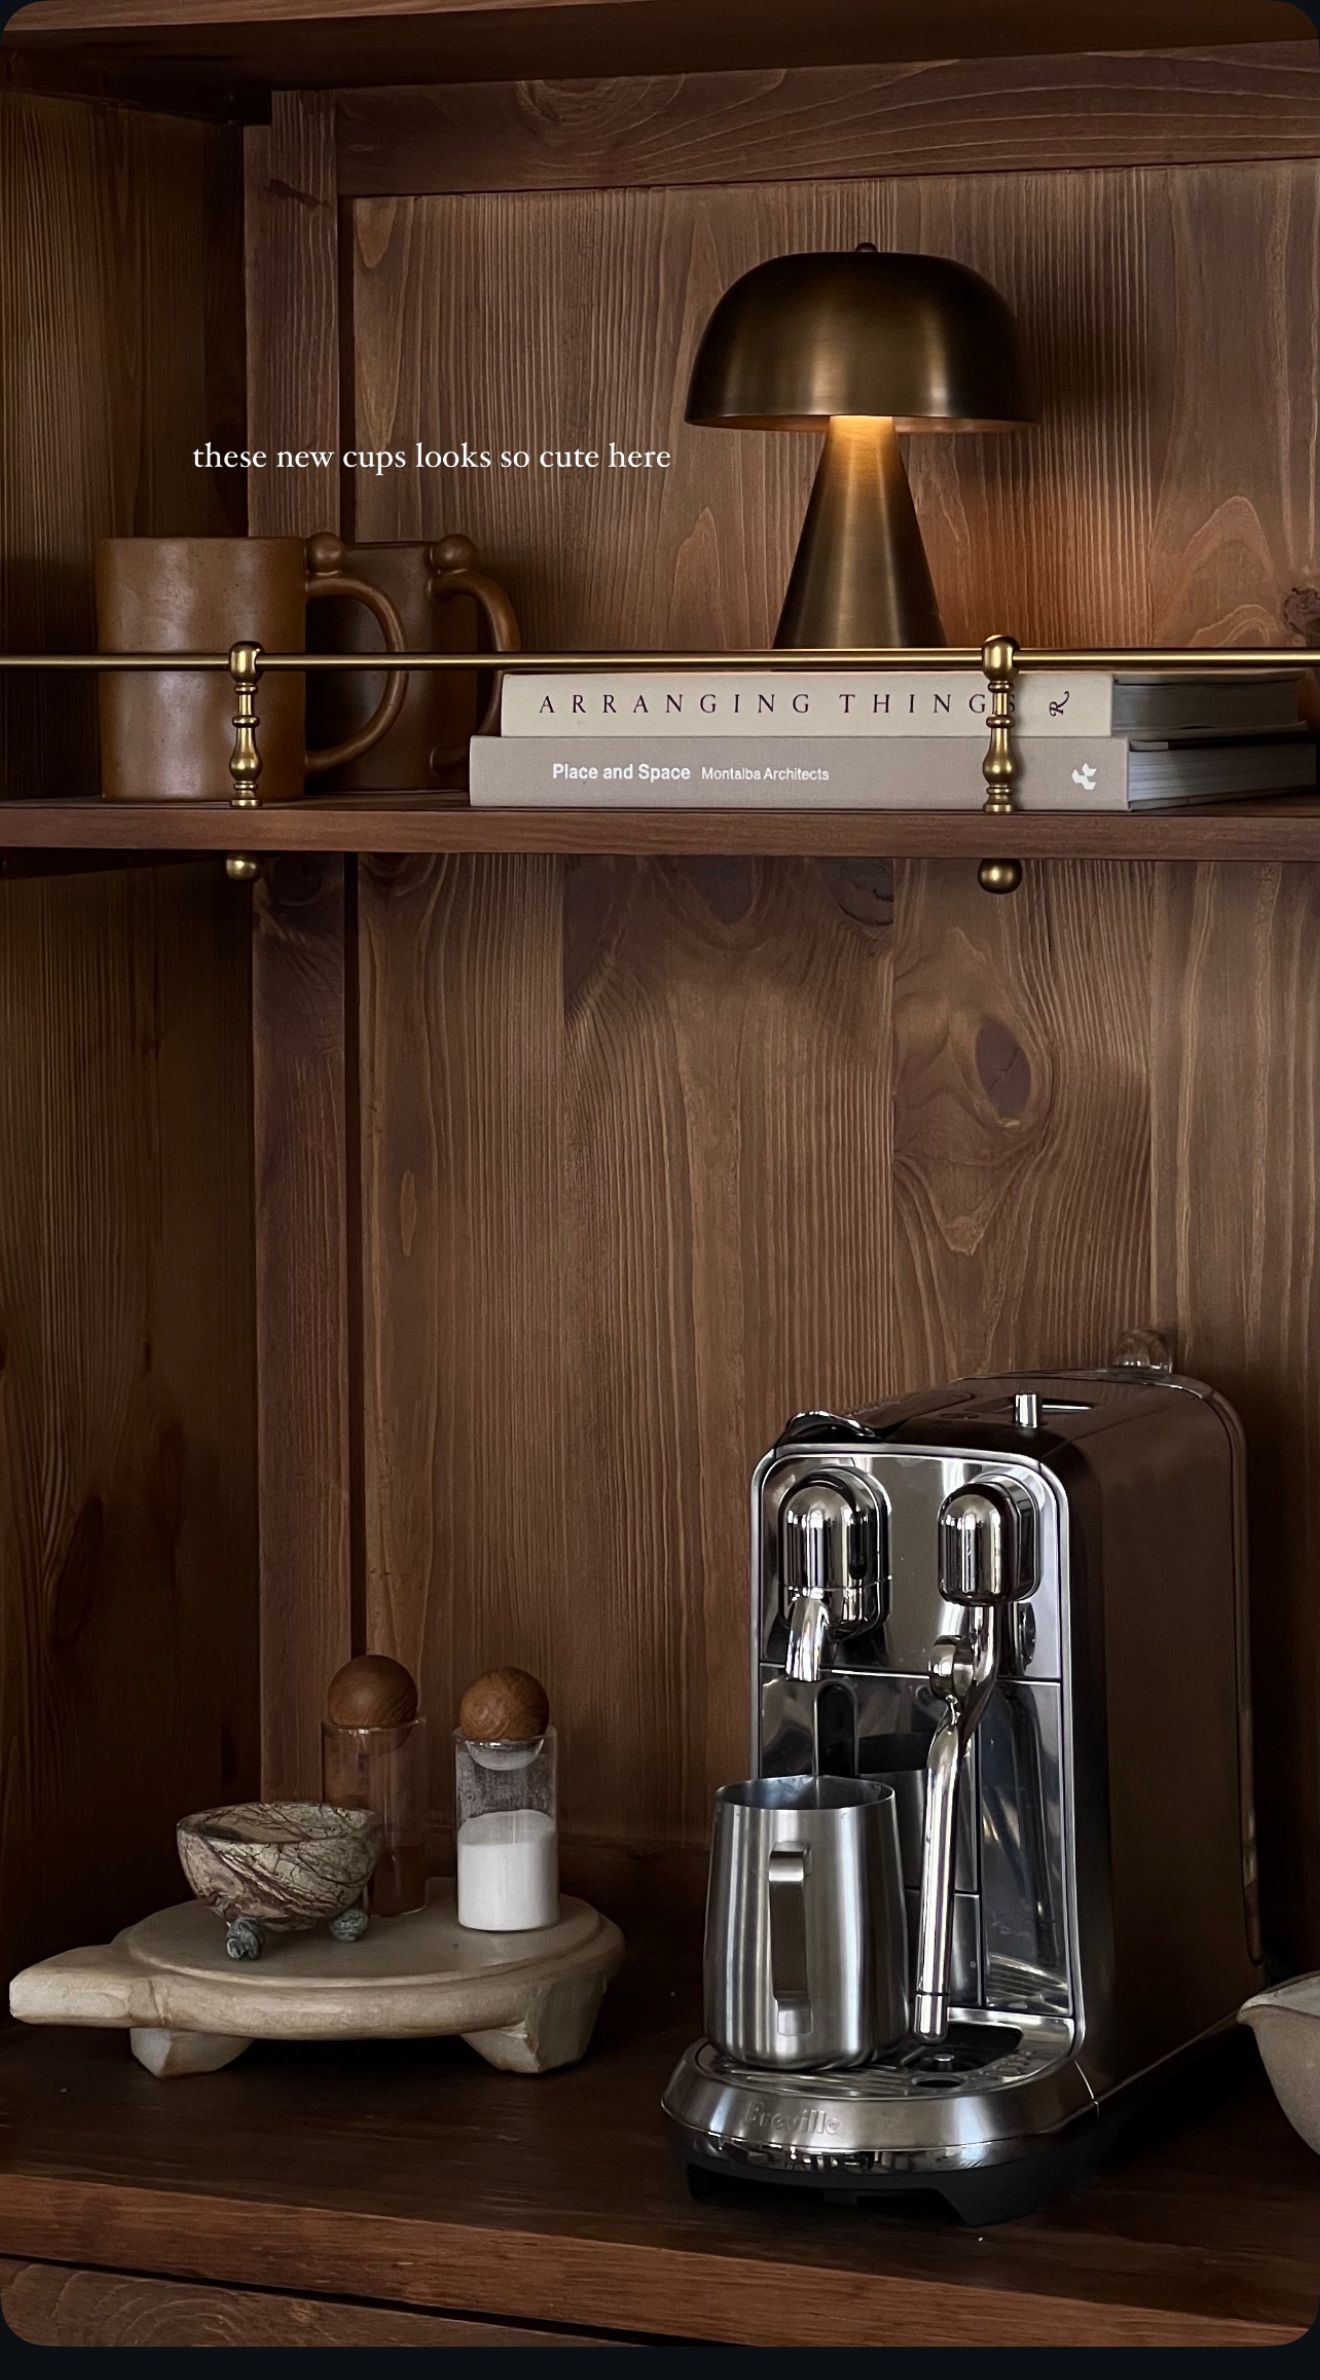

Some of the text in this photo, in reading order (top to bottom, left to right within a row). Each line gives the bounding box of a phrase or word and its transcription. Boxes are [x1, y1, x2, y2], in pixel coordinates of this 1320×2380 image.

[538, 693, 810, 715] ARRANGING
[552, 762, 831, 784] Place and Space Montalba Architects
[744, 2100, 841, 2136] Breville
